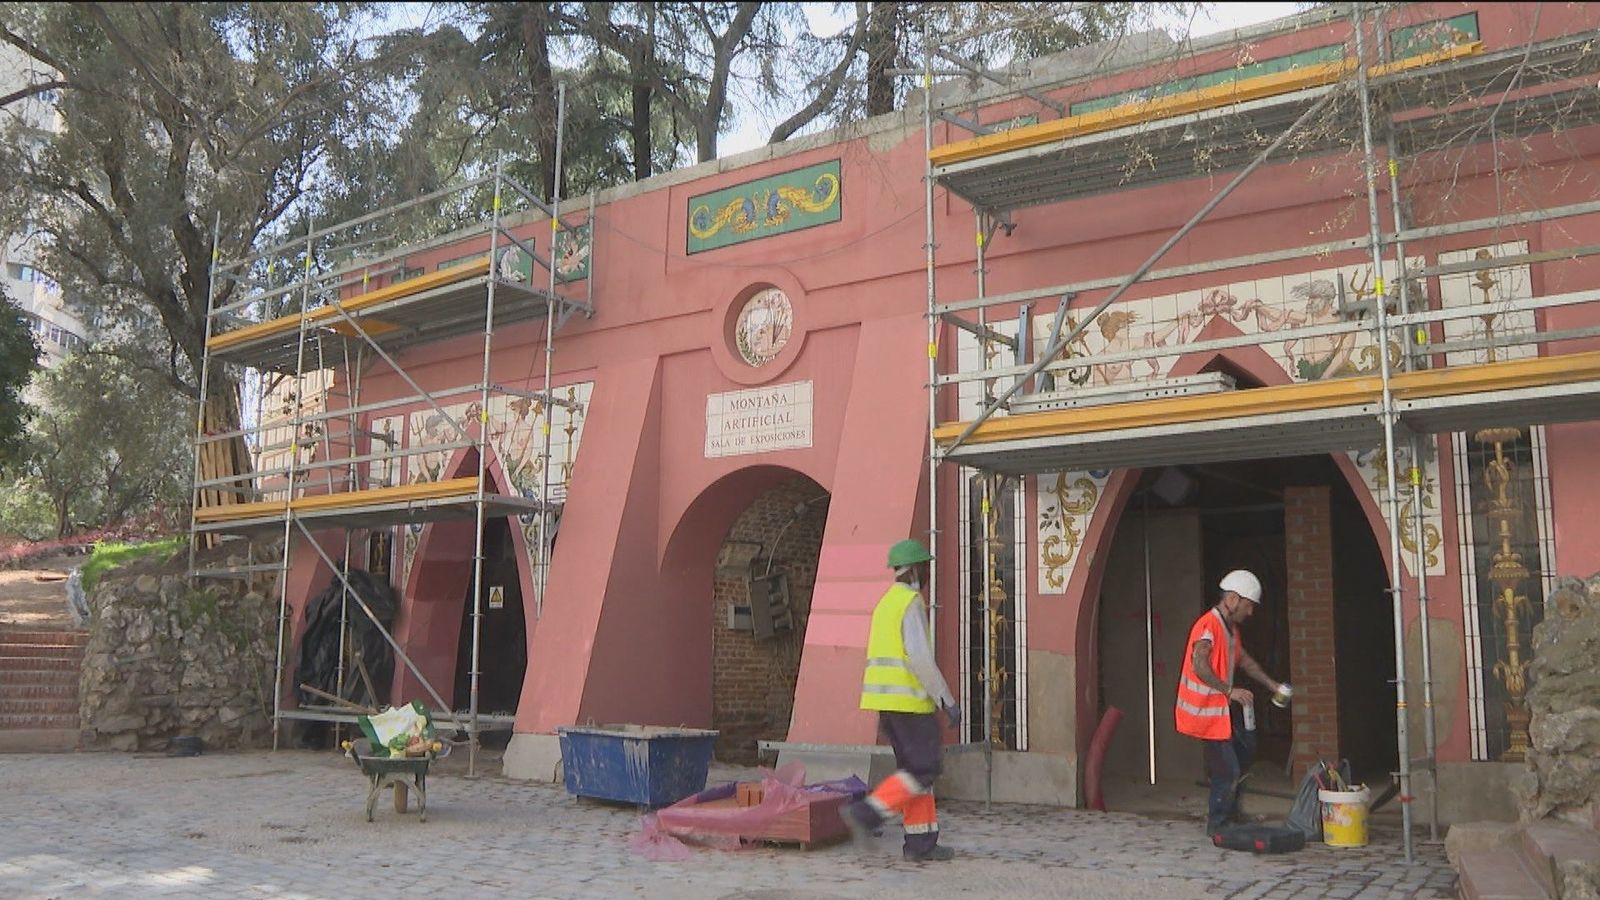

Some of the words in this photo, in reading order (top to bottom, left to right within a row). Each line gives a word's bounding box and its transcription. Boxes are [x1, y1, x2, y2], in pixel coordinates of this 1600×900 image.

[730, 393, 788, 411] MONTAÑA
[724, 412, 792, 430] ARTIFICIAL
[711, 439, 730, 449] SALA
[735, 436, 745, 446] DE
[750, 430, 806, 445] EXPOSICIONES
